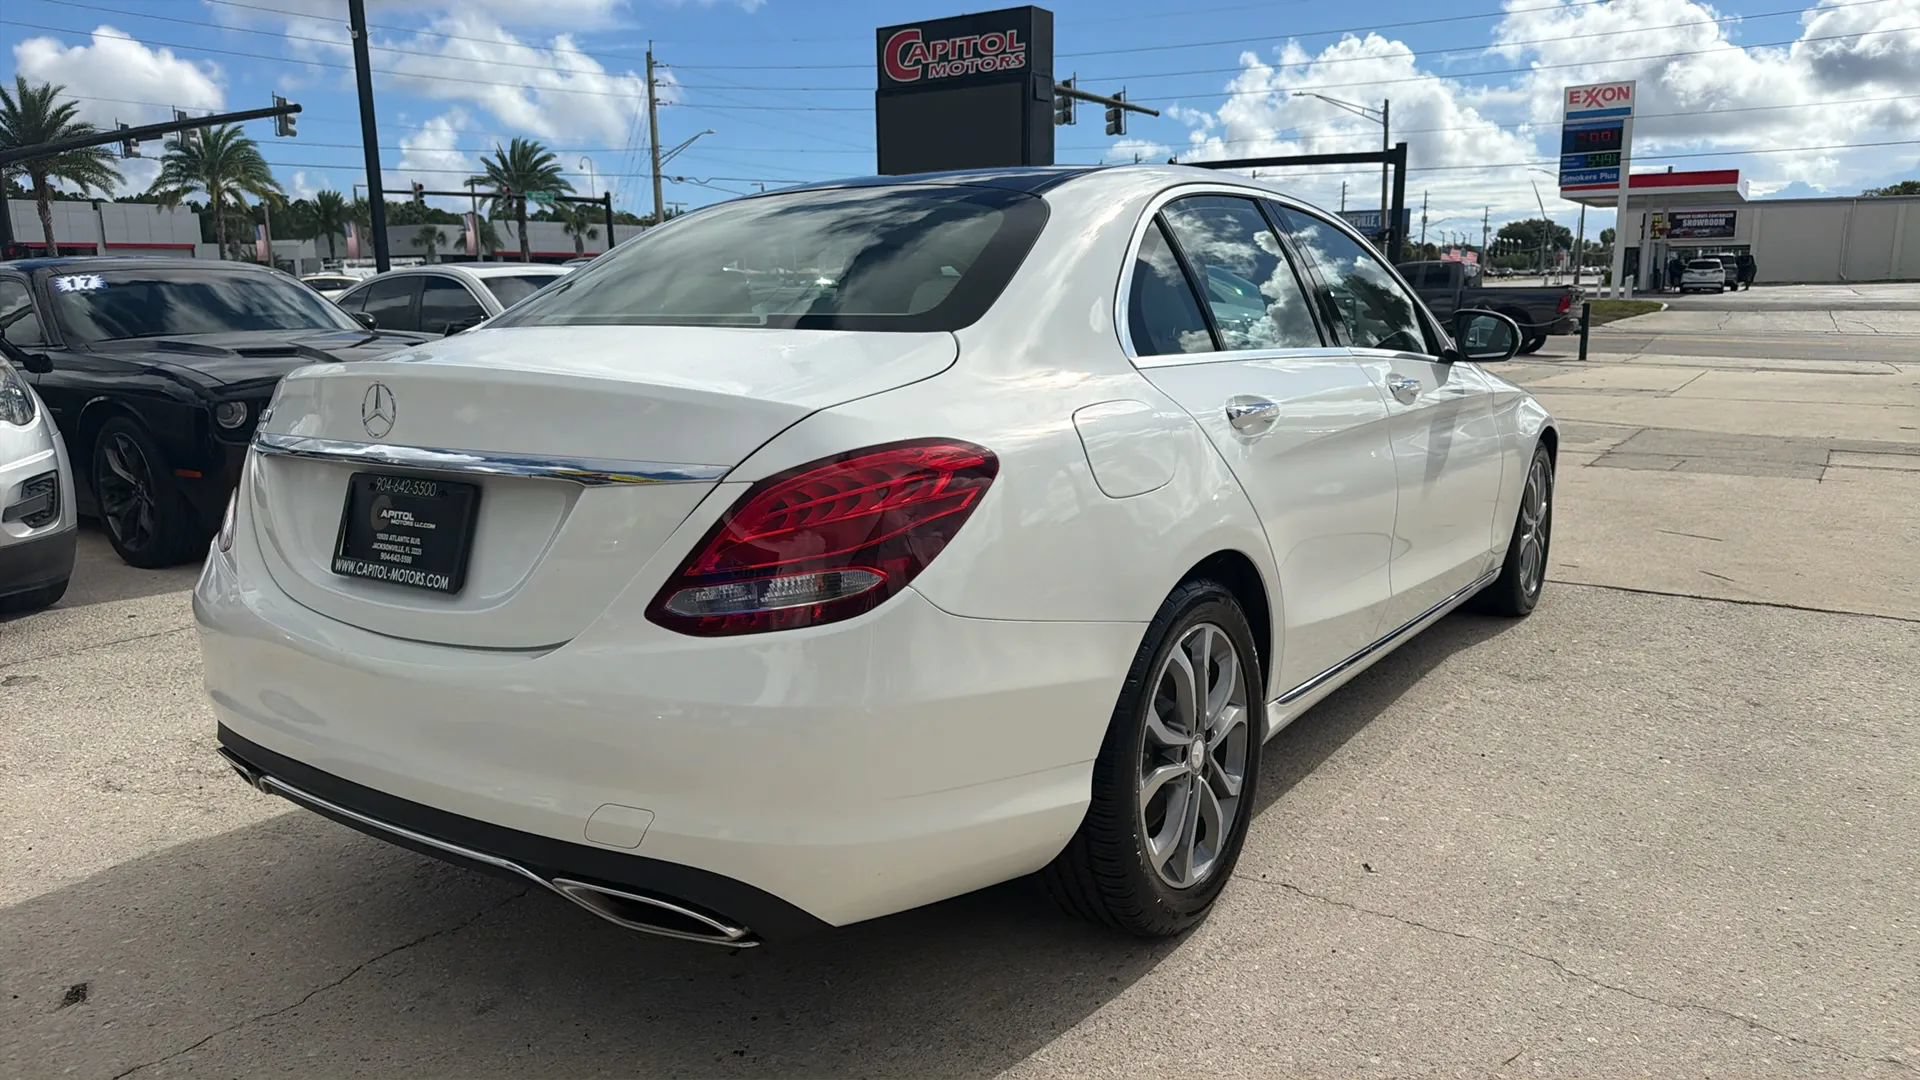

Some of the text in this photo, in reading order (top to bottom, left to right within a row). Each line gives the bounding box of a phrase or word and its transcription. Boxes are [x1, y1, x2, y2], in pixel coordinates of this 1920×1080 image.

[884, 29, 1026, 82] CAPITOL
[928, 52, 1026, 79] MOTORS
[1568, 86, 1630, 108] EXXON
[1561, 172, 1618, 184] Smokers Plus
[1682, 218, 1726, 227] SHOWROOM
[67, 277, 92, 288] 17
[376, 477, 437, 497] 904-642-5500
[390, 519, 414, 527] MOTORS
[389, 534, 410, 543] ATLANTIC
[335, 558, 449, 590] WWW.CAPITOL-MOTORS.COM
